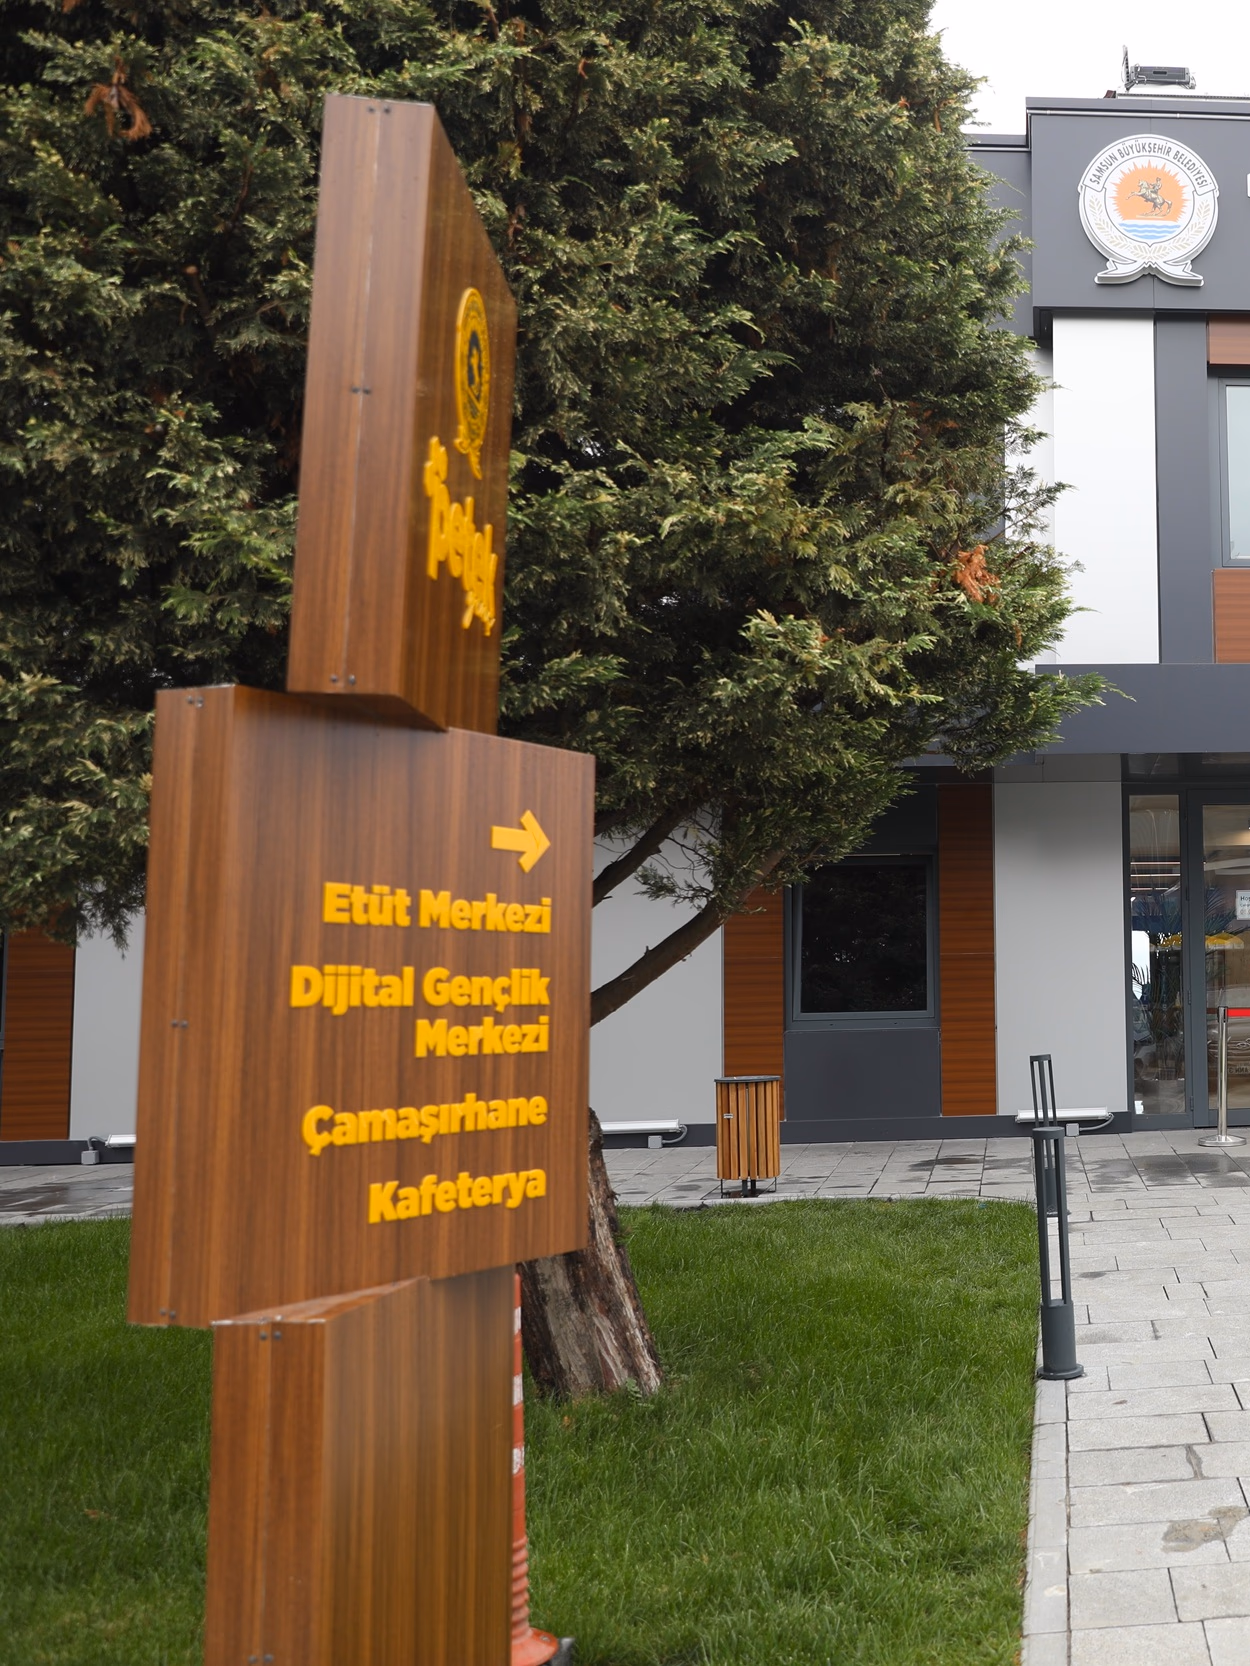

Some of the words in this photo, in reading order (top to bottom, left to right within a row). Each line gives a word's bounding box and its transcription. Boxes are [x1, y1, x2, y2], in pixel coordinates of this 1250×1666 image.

[1089, 152, 1119, 185] SAMSUN
[1117, 140, 1172, 158] BÜYÜKŞEHİR
[1173, 150, 1213, 188] BELEDİYESİ
[322, 881, 412, 928] Etüt
[419, 889, 552, 933] Merkezi
[290, 965, 414, 1016] Dijital
[422, 966, 551, 1013] Gençlik
[415, 1016, 550, 1058] Merkezi
[302, 1093, 548, 1156] Çamaşırhane
[368, 1168, 547, 1224] Kafeterya
